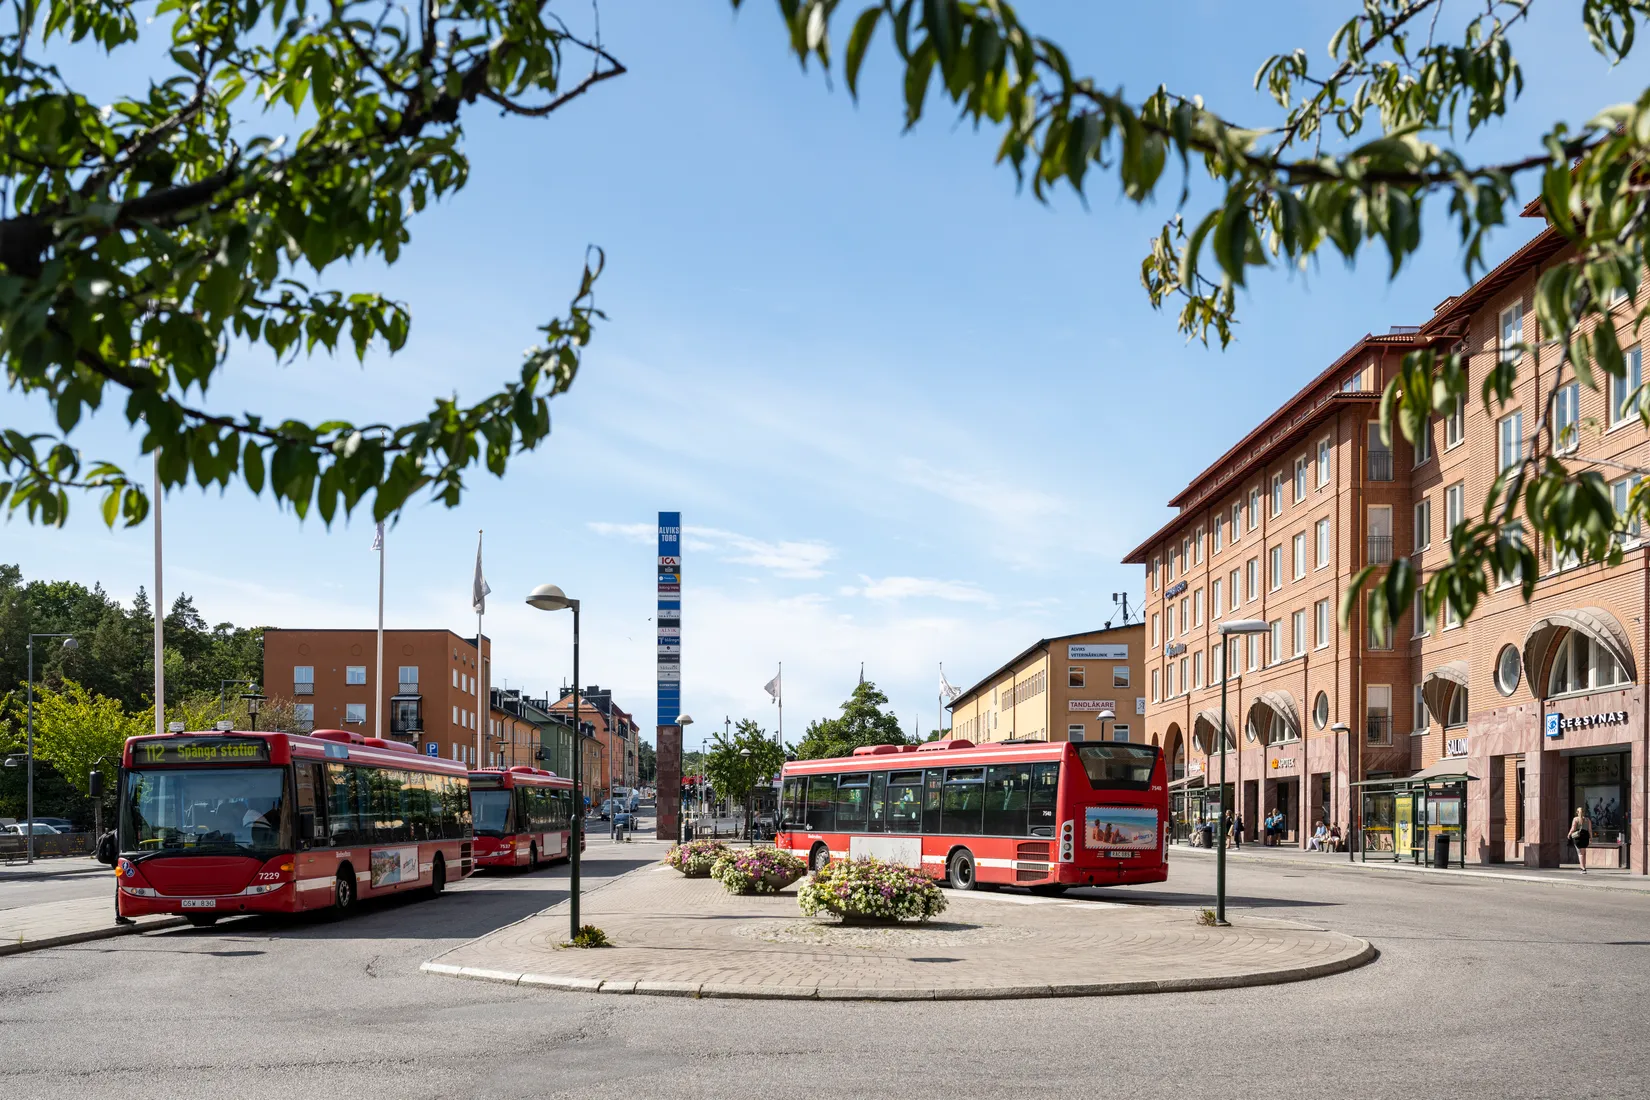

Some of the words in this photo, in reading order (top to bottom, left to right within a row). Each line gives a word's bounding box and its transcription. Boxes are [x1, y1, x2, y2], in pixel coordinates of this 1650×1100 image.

[659, 526, 680, 534] ALVIKS
[661, 534, 677, 542] TORG
[661, 557, 676, 565] ICA
[1560, 711, 1624, 728] SE&SYNAS
[429, 743, 436, 753] P
[144, 744, 166, 762] 112
[178, 743, 217, 760] Spånga
[258, 872, 280, 880] 7229
